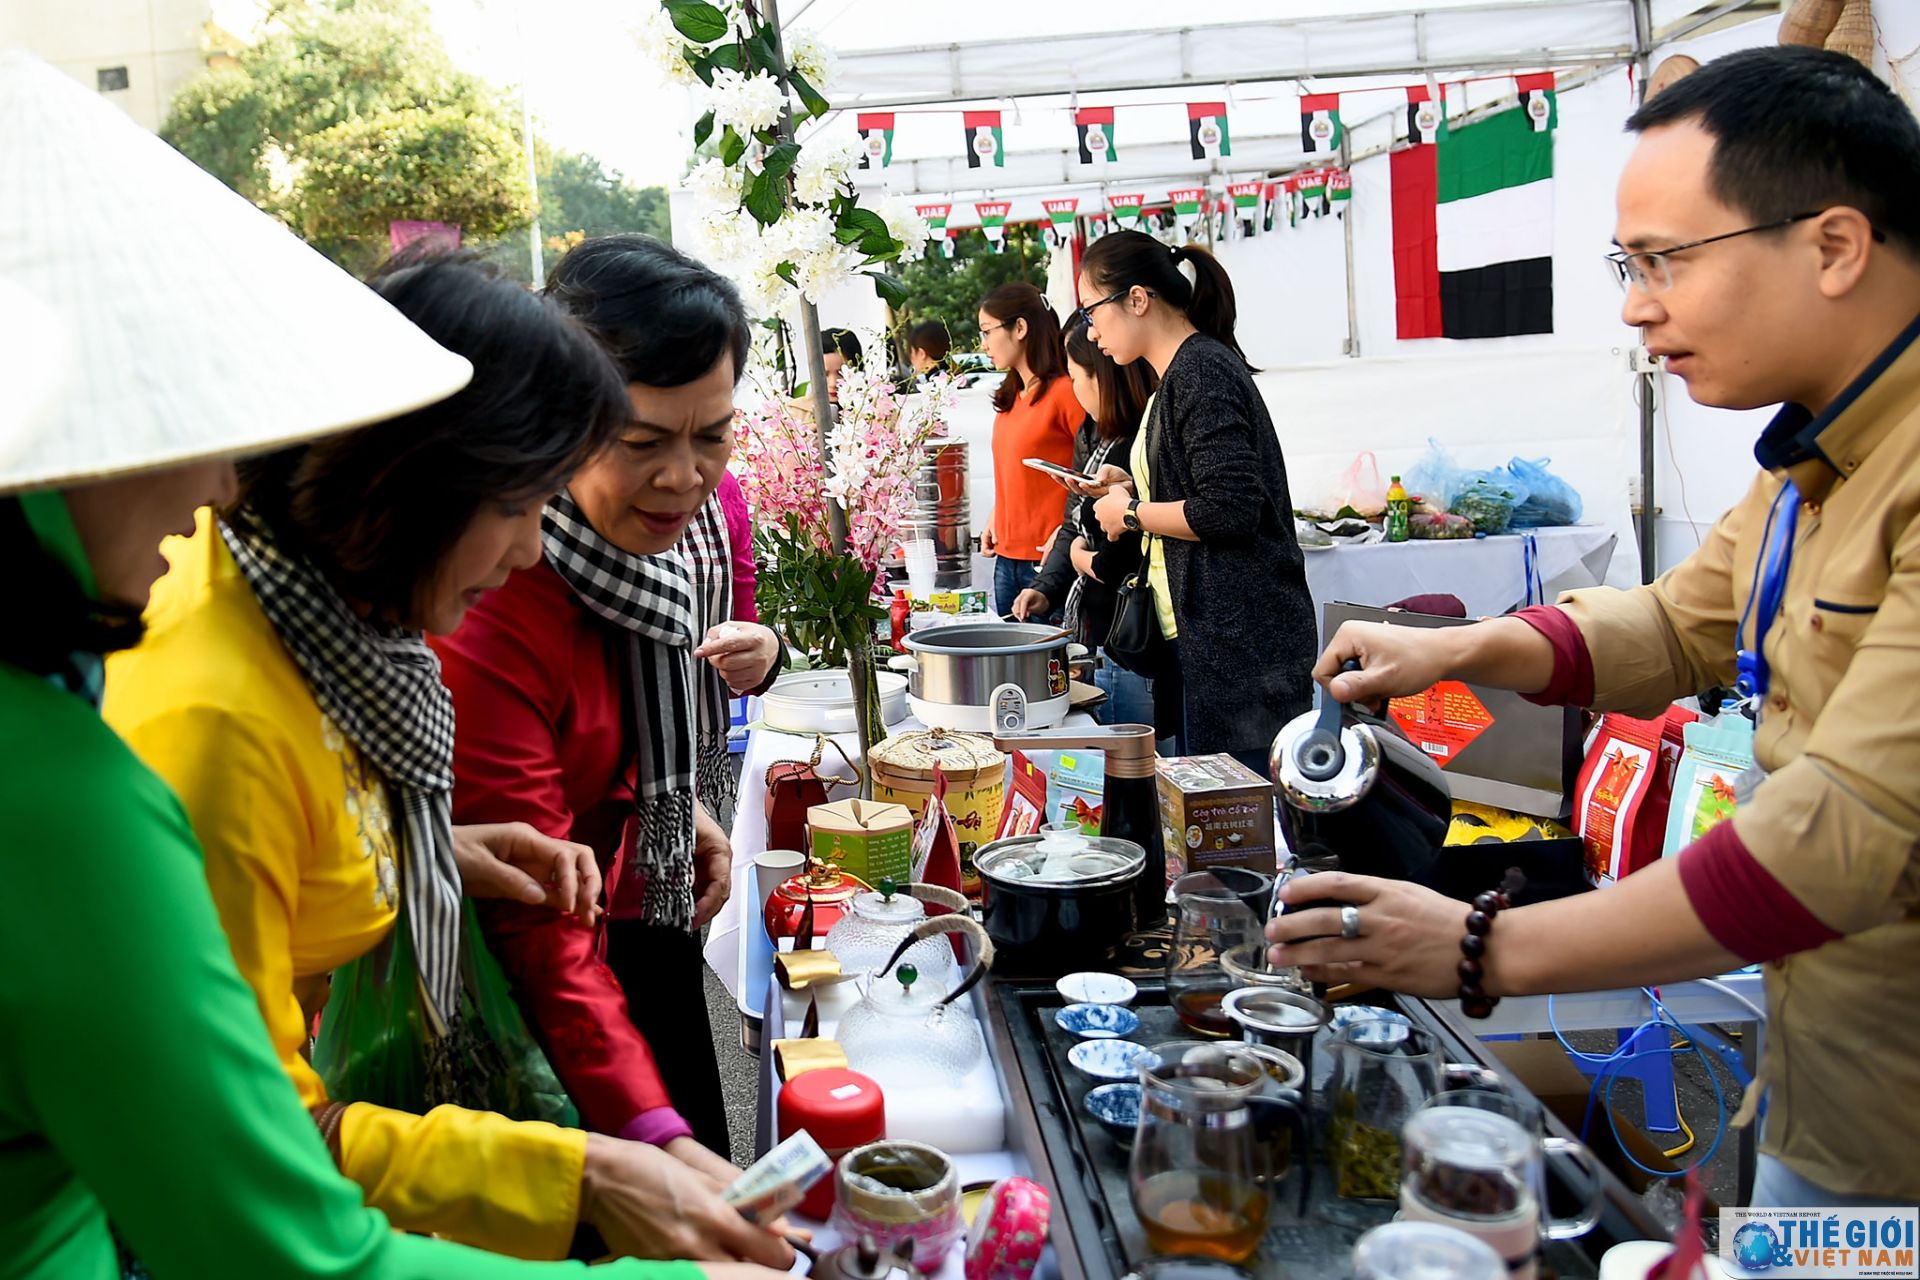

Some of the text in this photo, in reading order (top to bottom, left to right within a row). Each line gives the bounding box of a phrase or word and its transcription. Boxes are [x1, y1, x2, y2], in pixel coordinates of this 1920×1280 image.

[1298, 176, 1323, 189] UAE
[1174, 191, 1198, 202] UAE
[1233, 185, 1257, 196] UAE
[1048, 201, 1073, 213] UAE
[1113, 196, 1139, 207] UAE
[920, 206, 946, 218] UAE
[981, 205, 1006, 217] UAE
